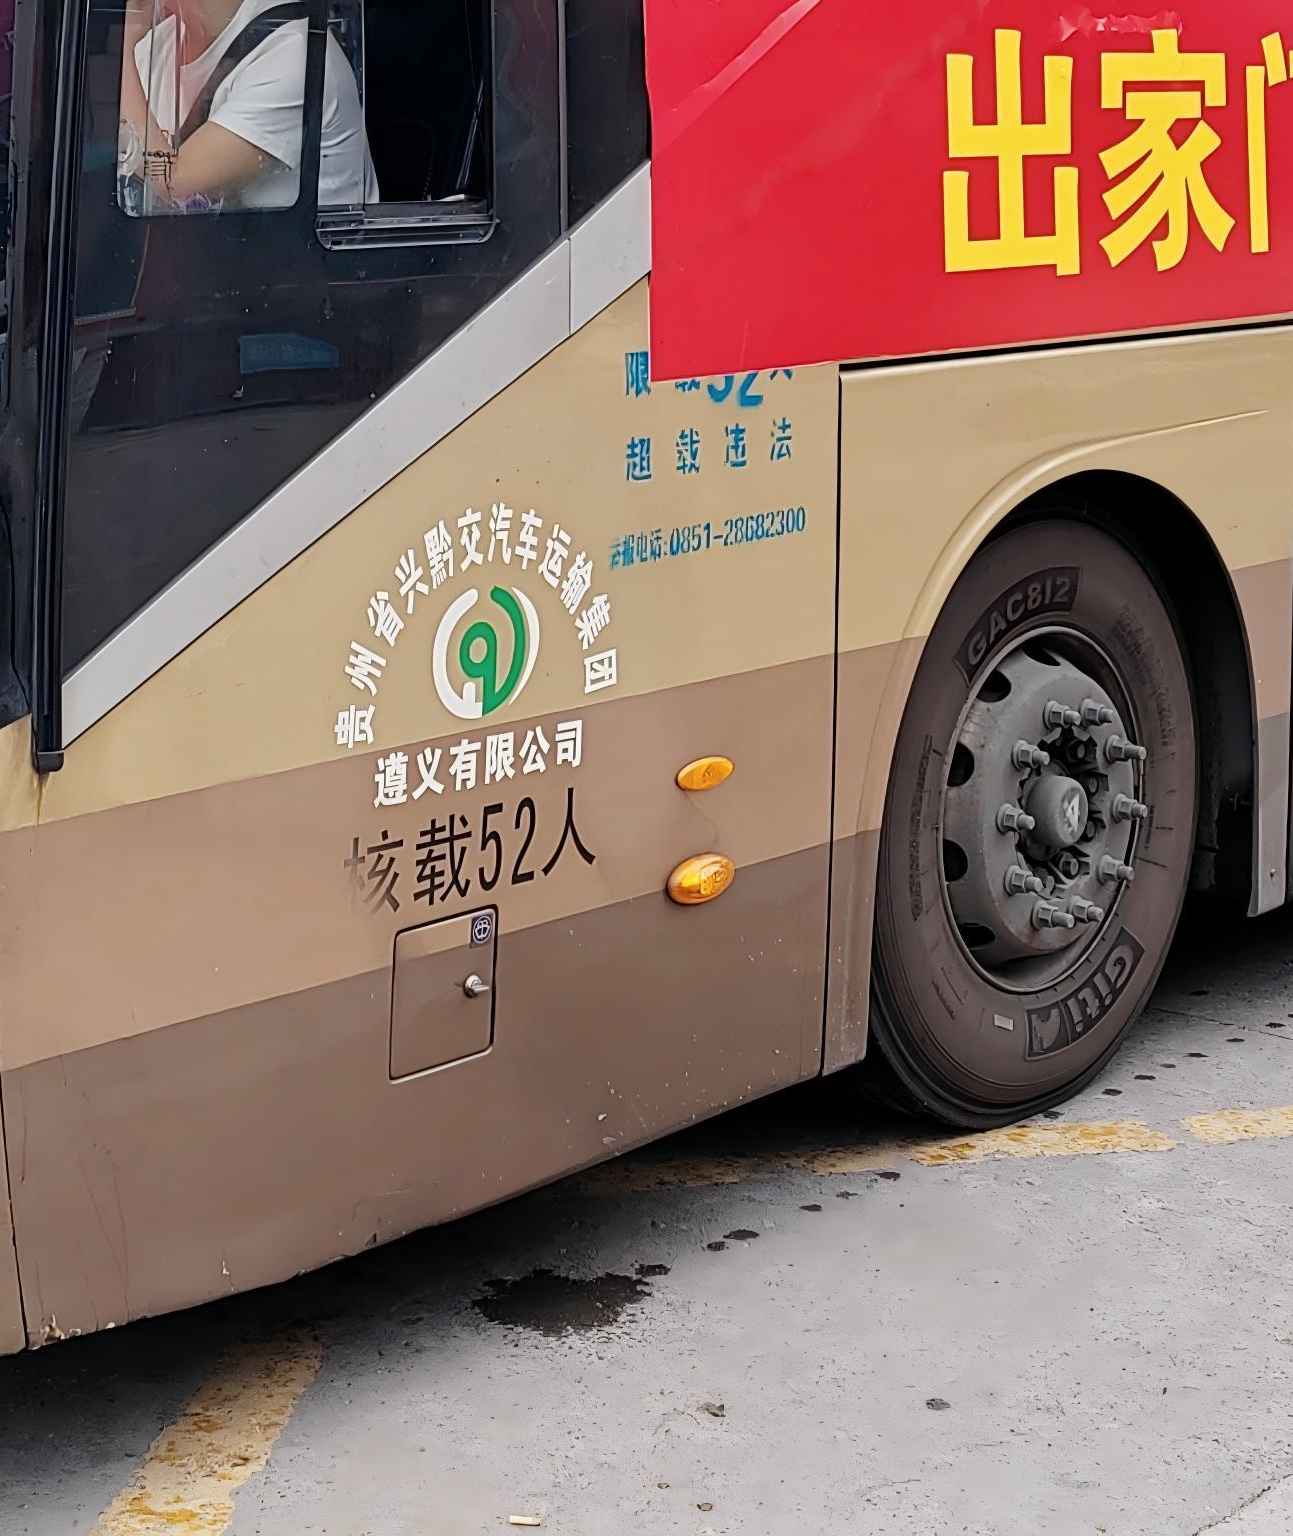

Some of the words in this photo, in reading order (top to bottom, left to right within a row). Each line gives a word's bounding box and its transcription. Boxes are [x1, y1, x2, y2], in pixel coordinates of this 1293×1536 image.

[625, 417, 793, 481] 超载违法
[334, 501, 619, 749] 贵州省兴黔交汽车运输集团
[967, 575, 1074, 666] GAC812
[373, 719, 584, 808] 遵义有限公司
[343, 786, 597, 916] 核载52人
